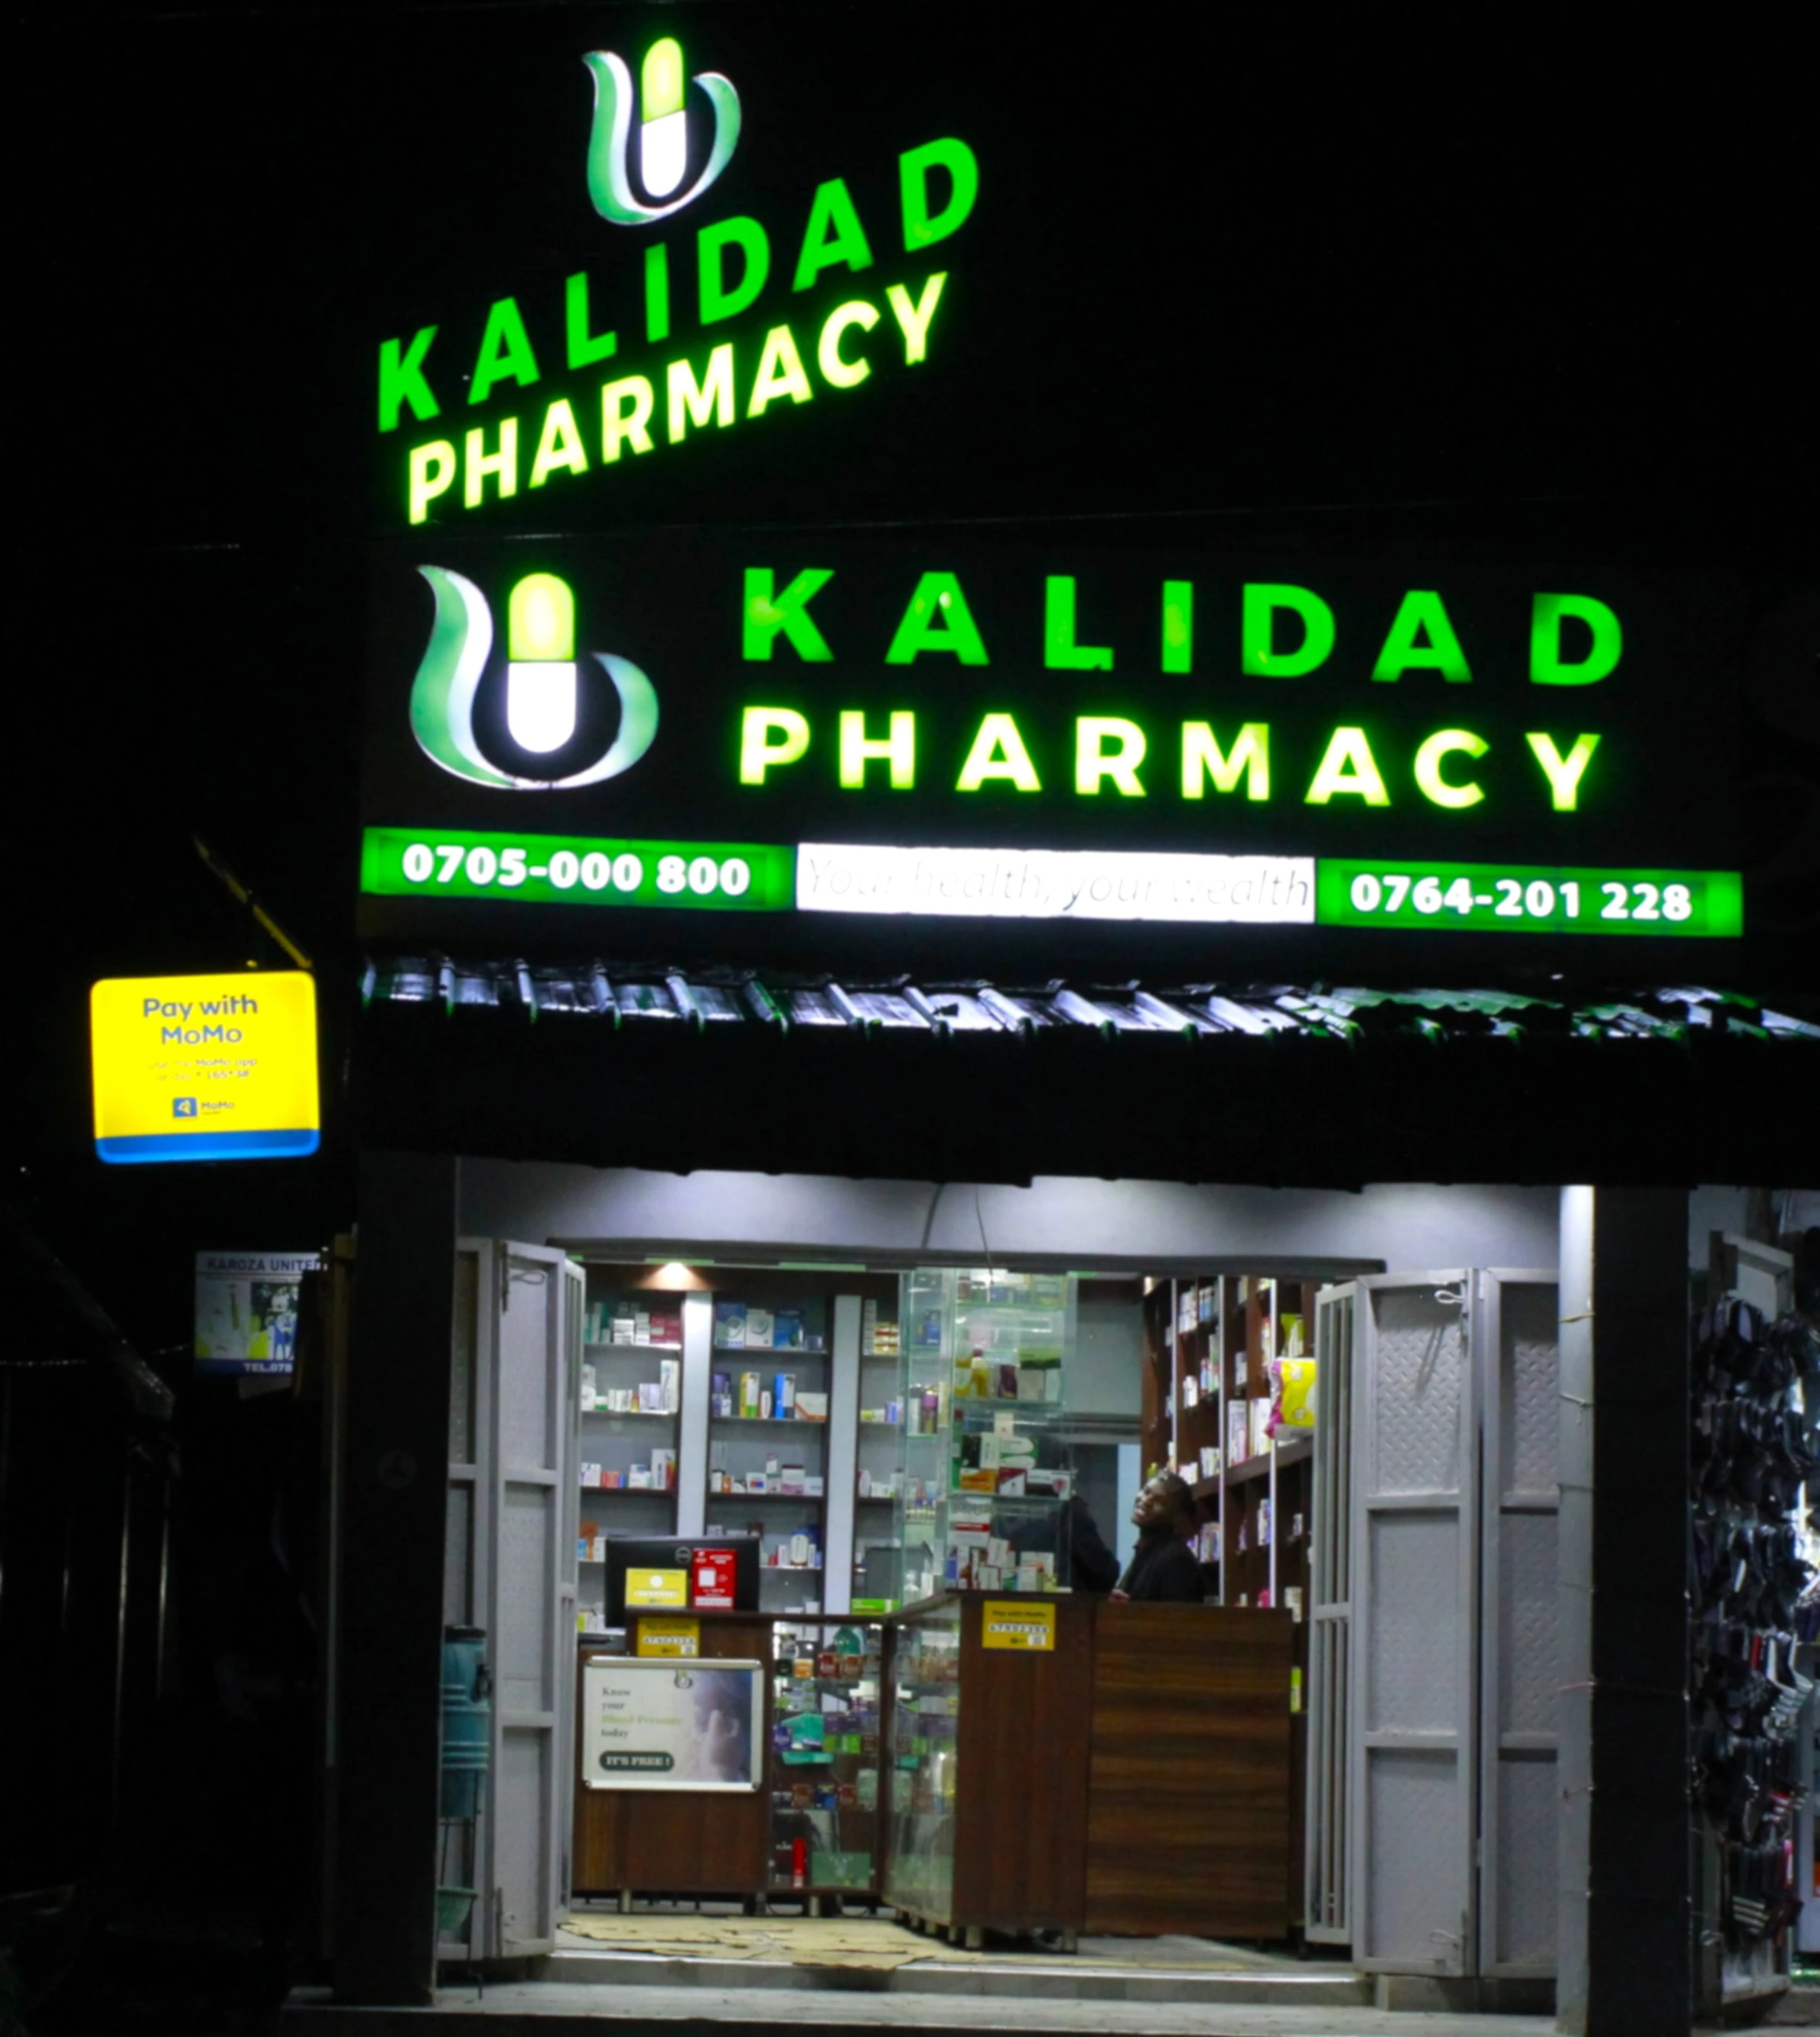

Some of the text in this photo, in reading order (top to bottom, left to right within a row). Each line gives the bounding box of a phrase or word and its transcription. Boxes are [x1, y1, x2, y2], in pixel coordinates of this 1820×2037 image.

[379, 138, 978, 432] KALIDAD
[408, 272, 948, 526] PHARMACY
[743, 568, 1622, 685] KALIDAD
[739, 705, 1601, 811] PHARMACY
[402, 845, 750, 895] 0705-000 800
[808, 858, 1310, 912] Your health, your wealth
[1351, 875, 1691, 921] 0764-201 228
[143, 994, 258, 1021] Pay with
[161, 1024, 243, 1045] MoMo
[208, 1259, 265, 1271] KAROZA
[602, 1687, 631, 1696] Know
